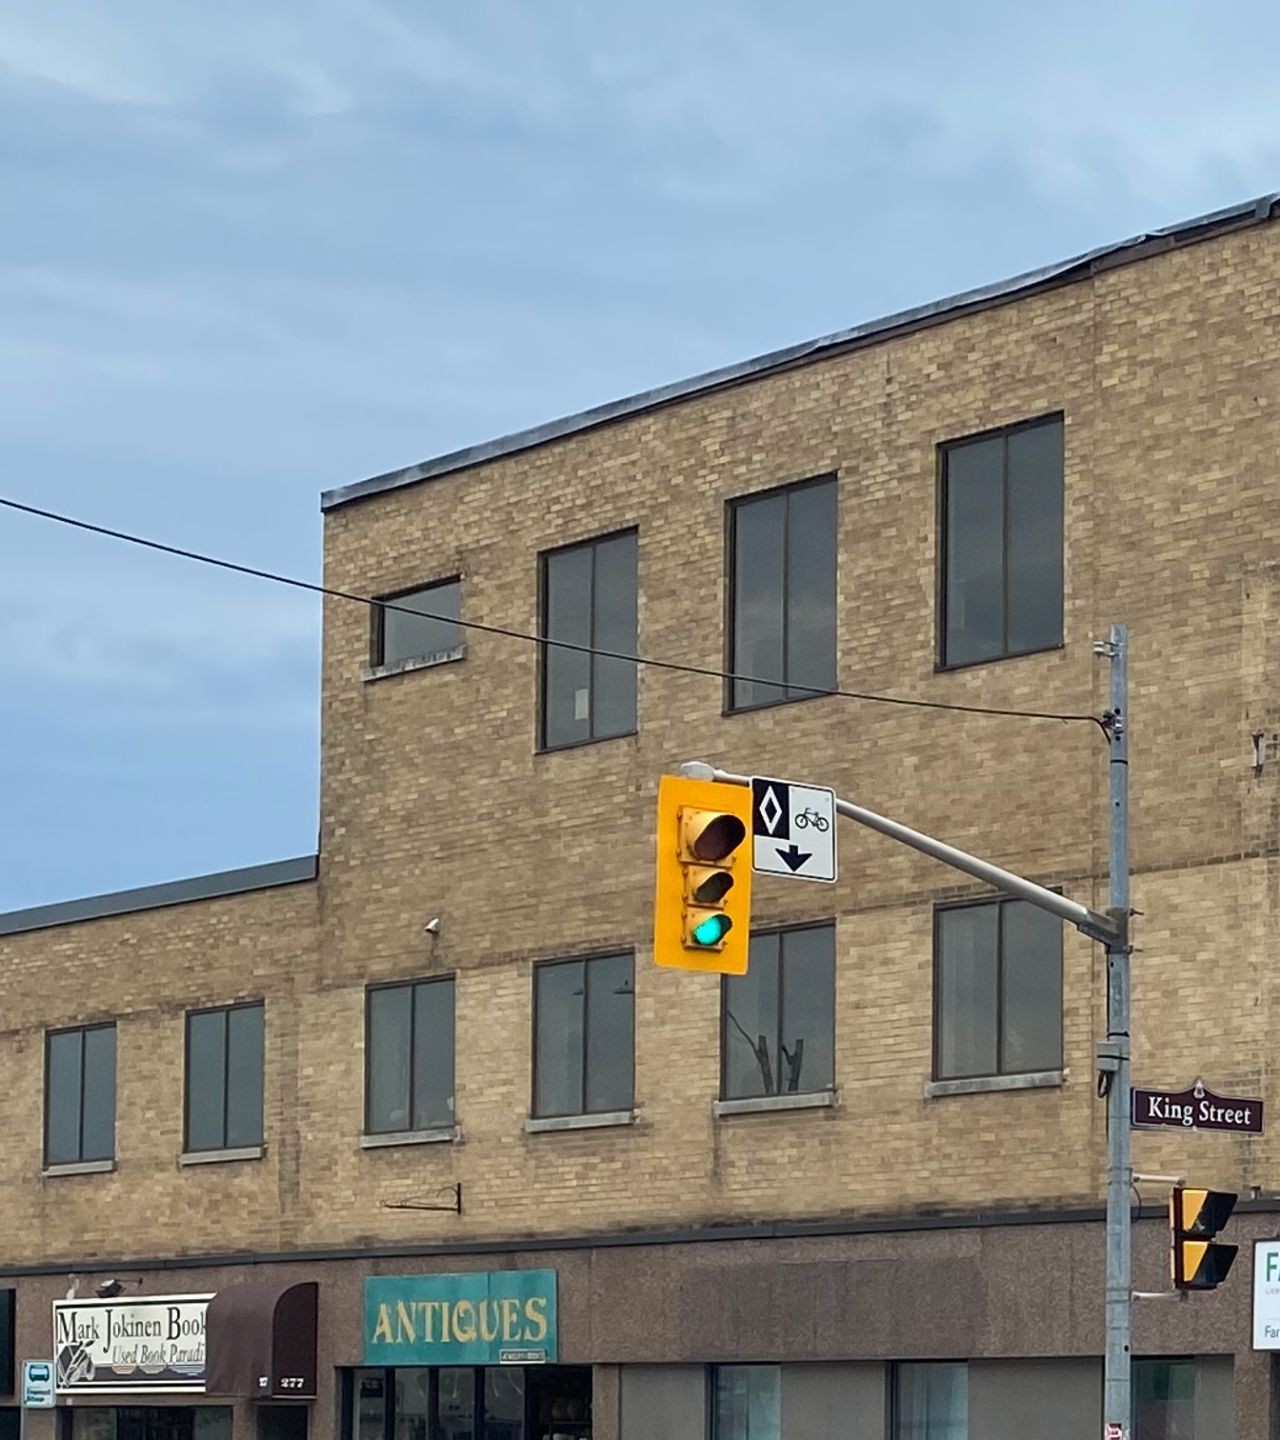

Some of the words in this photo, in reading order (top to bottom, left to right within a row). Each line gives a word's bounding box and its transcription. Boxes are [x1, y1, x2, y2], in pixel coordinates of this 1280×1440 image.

[1148, 1096, 1194, 1126] King
[1199, 1100, 1252, 1125] Street
[57, 1311, 99, 1344] Mark
[102, 1309, 162, 1353] Jokinen
[166, 1306, 206, 1341] Book
[371, 1297, 548, 1344] ANTIQUES
[112, 1344, 138, 1364] Used
[140, 1343, 167, 1364] Book
[280, 1377, 304, 1388] 277
